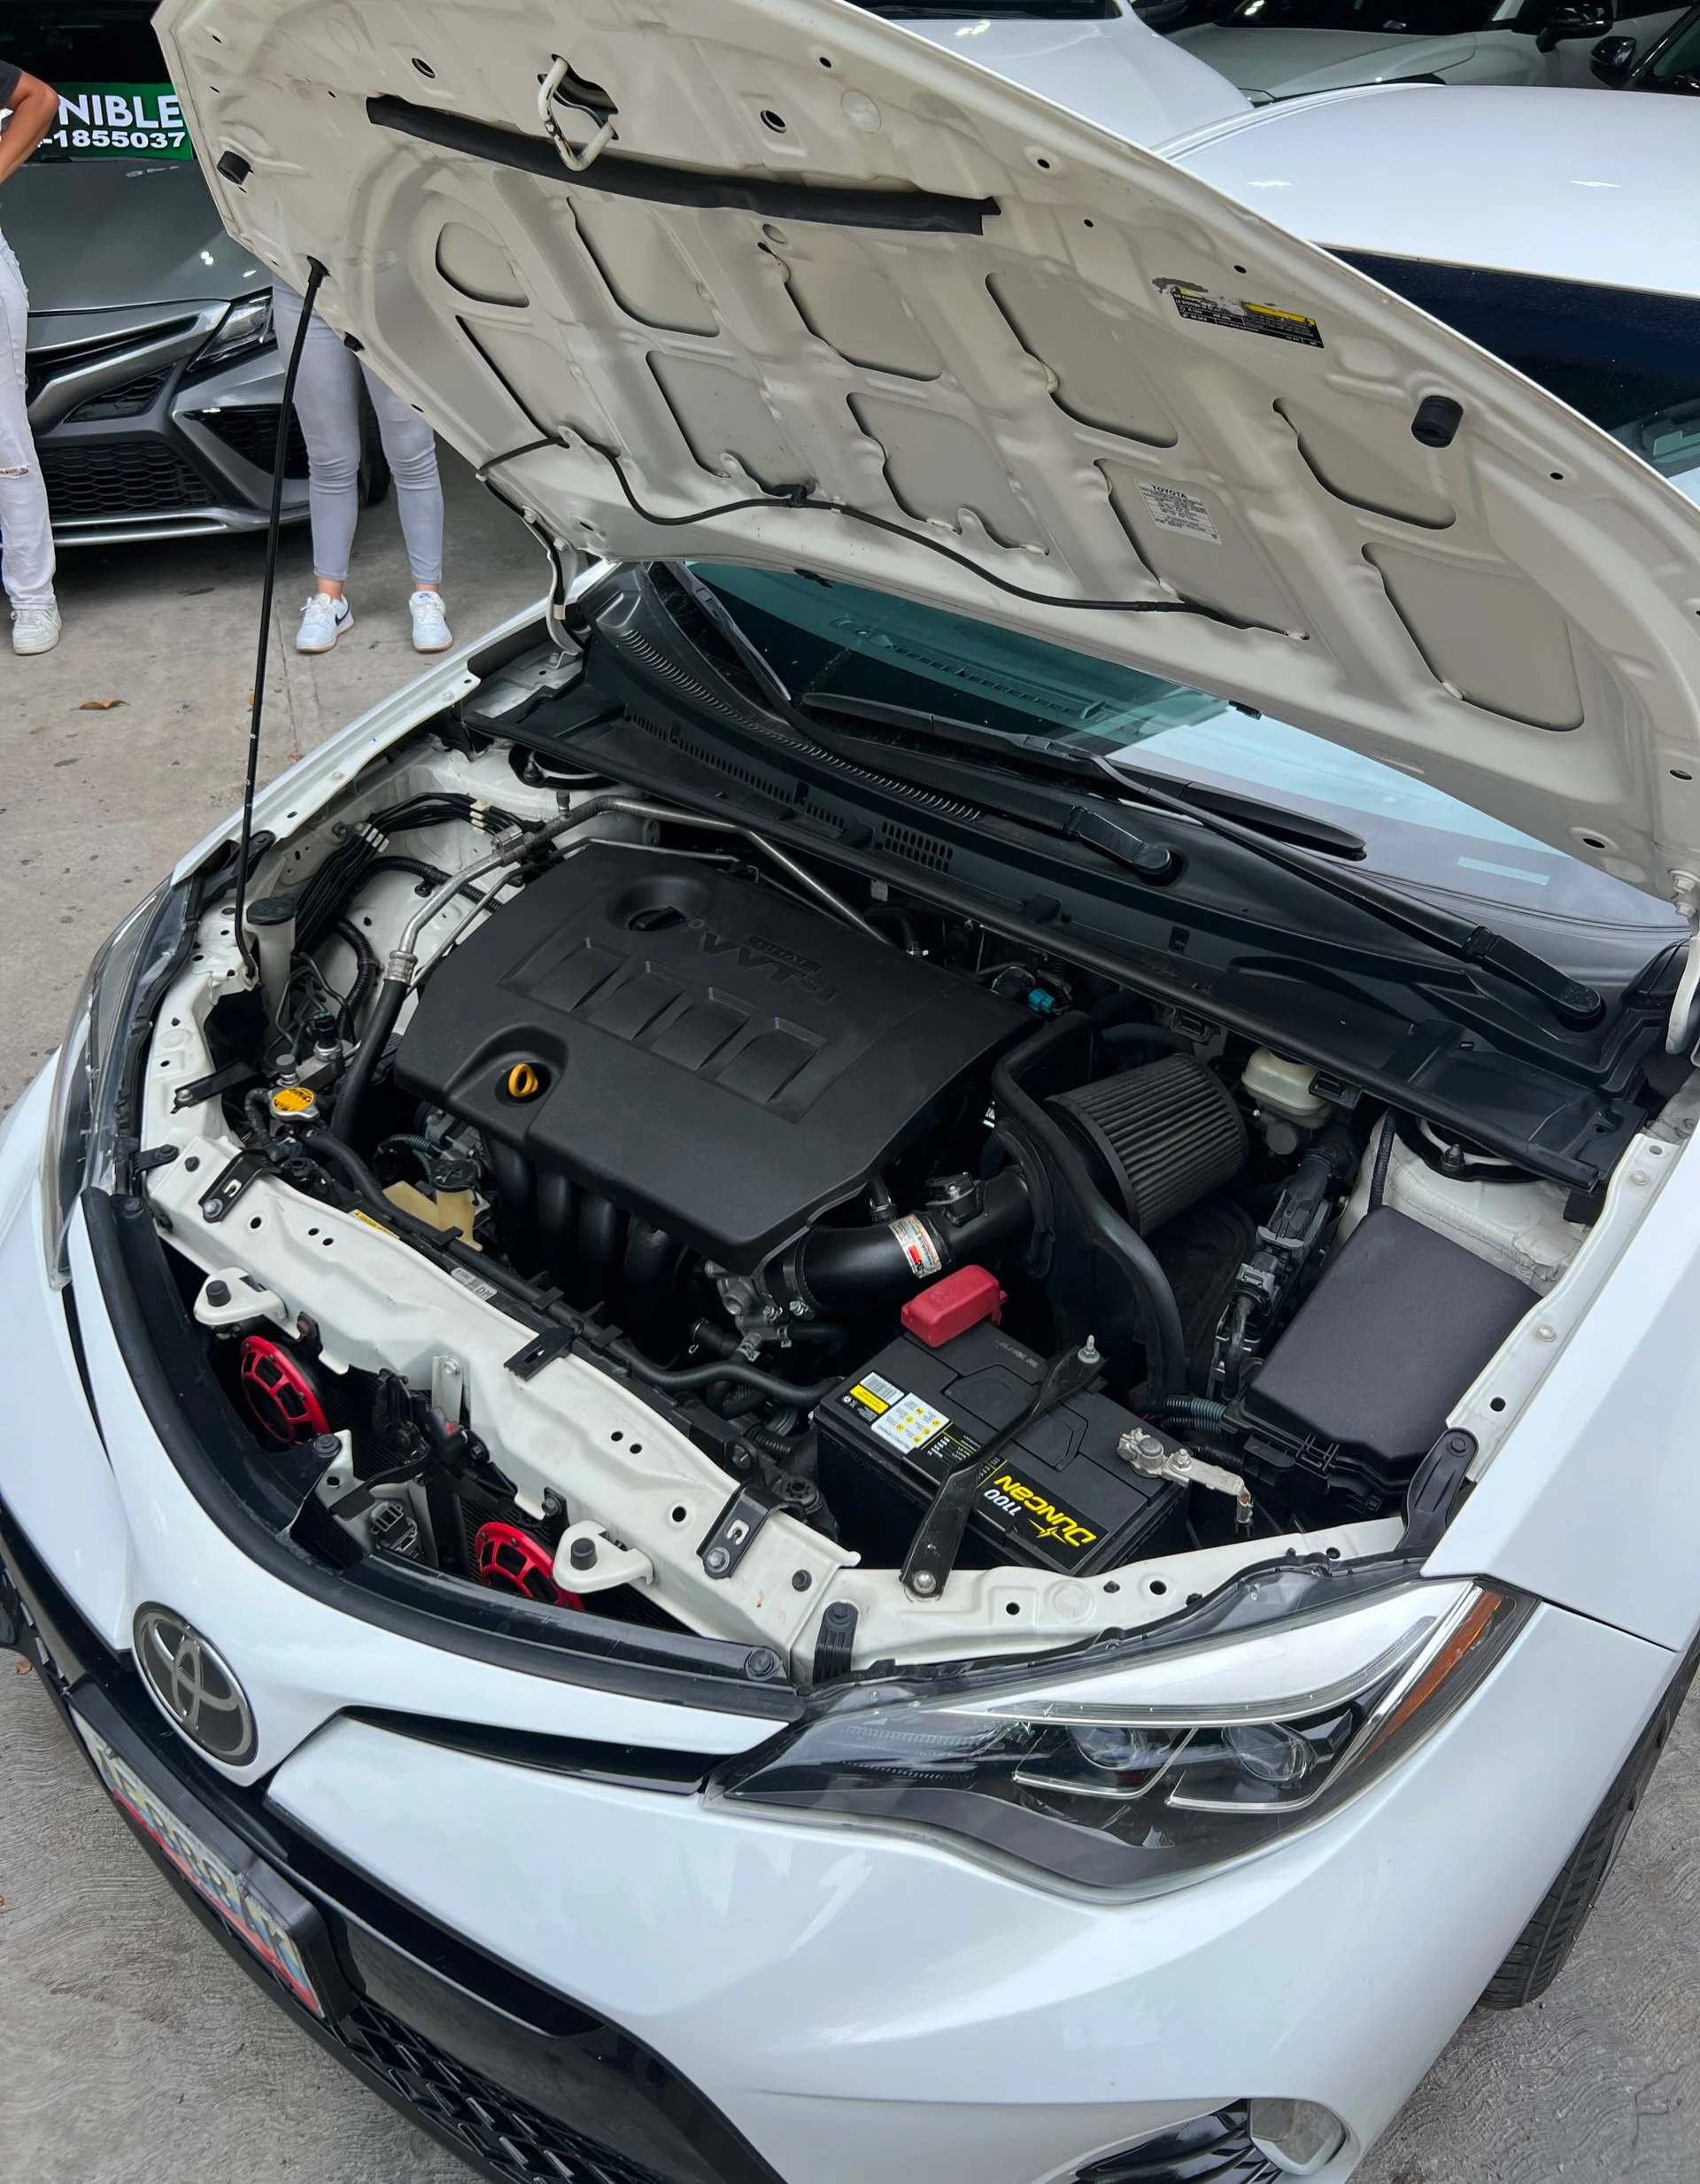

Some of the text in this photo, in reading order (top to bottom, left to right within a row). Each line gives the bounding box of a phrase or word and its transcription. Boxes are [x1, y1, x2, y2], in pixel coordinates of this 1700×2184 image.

[37, 129, 185, 149] -1855037
[1151, 484, 1187, 500] TOYOTA
[984, 1489, 1022, 1516] 1100
